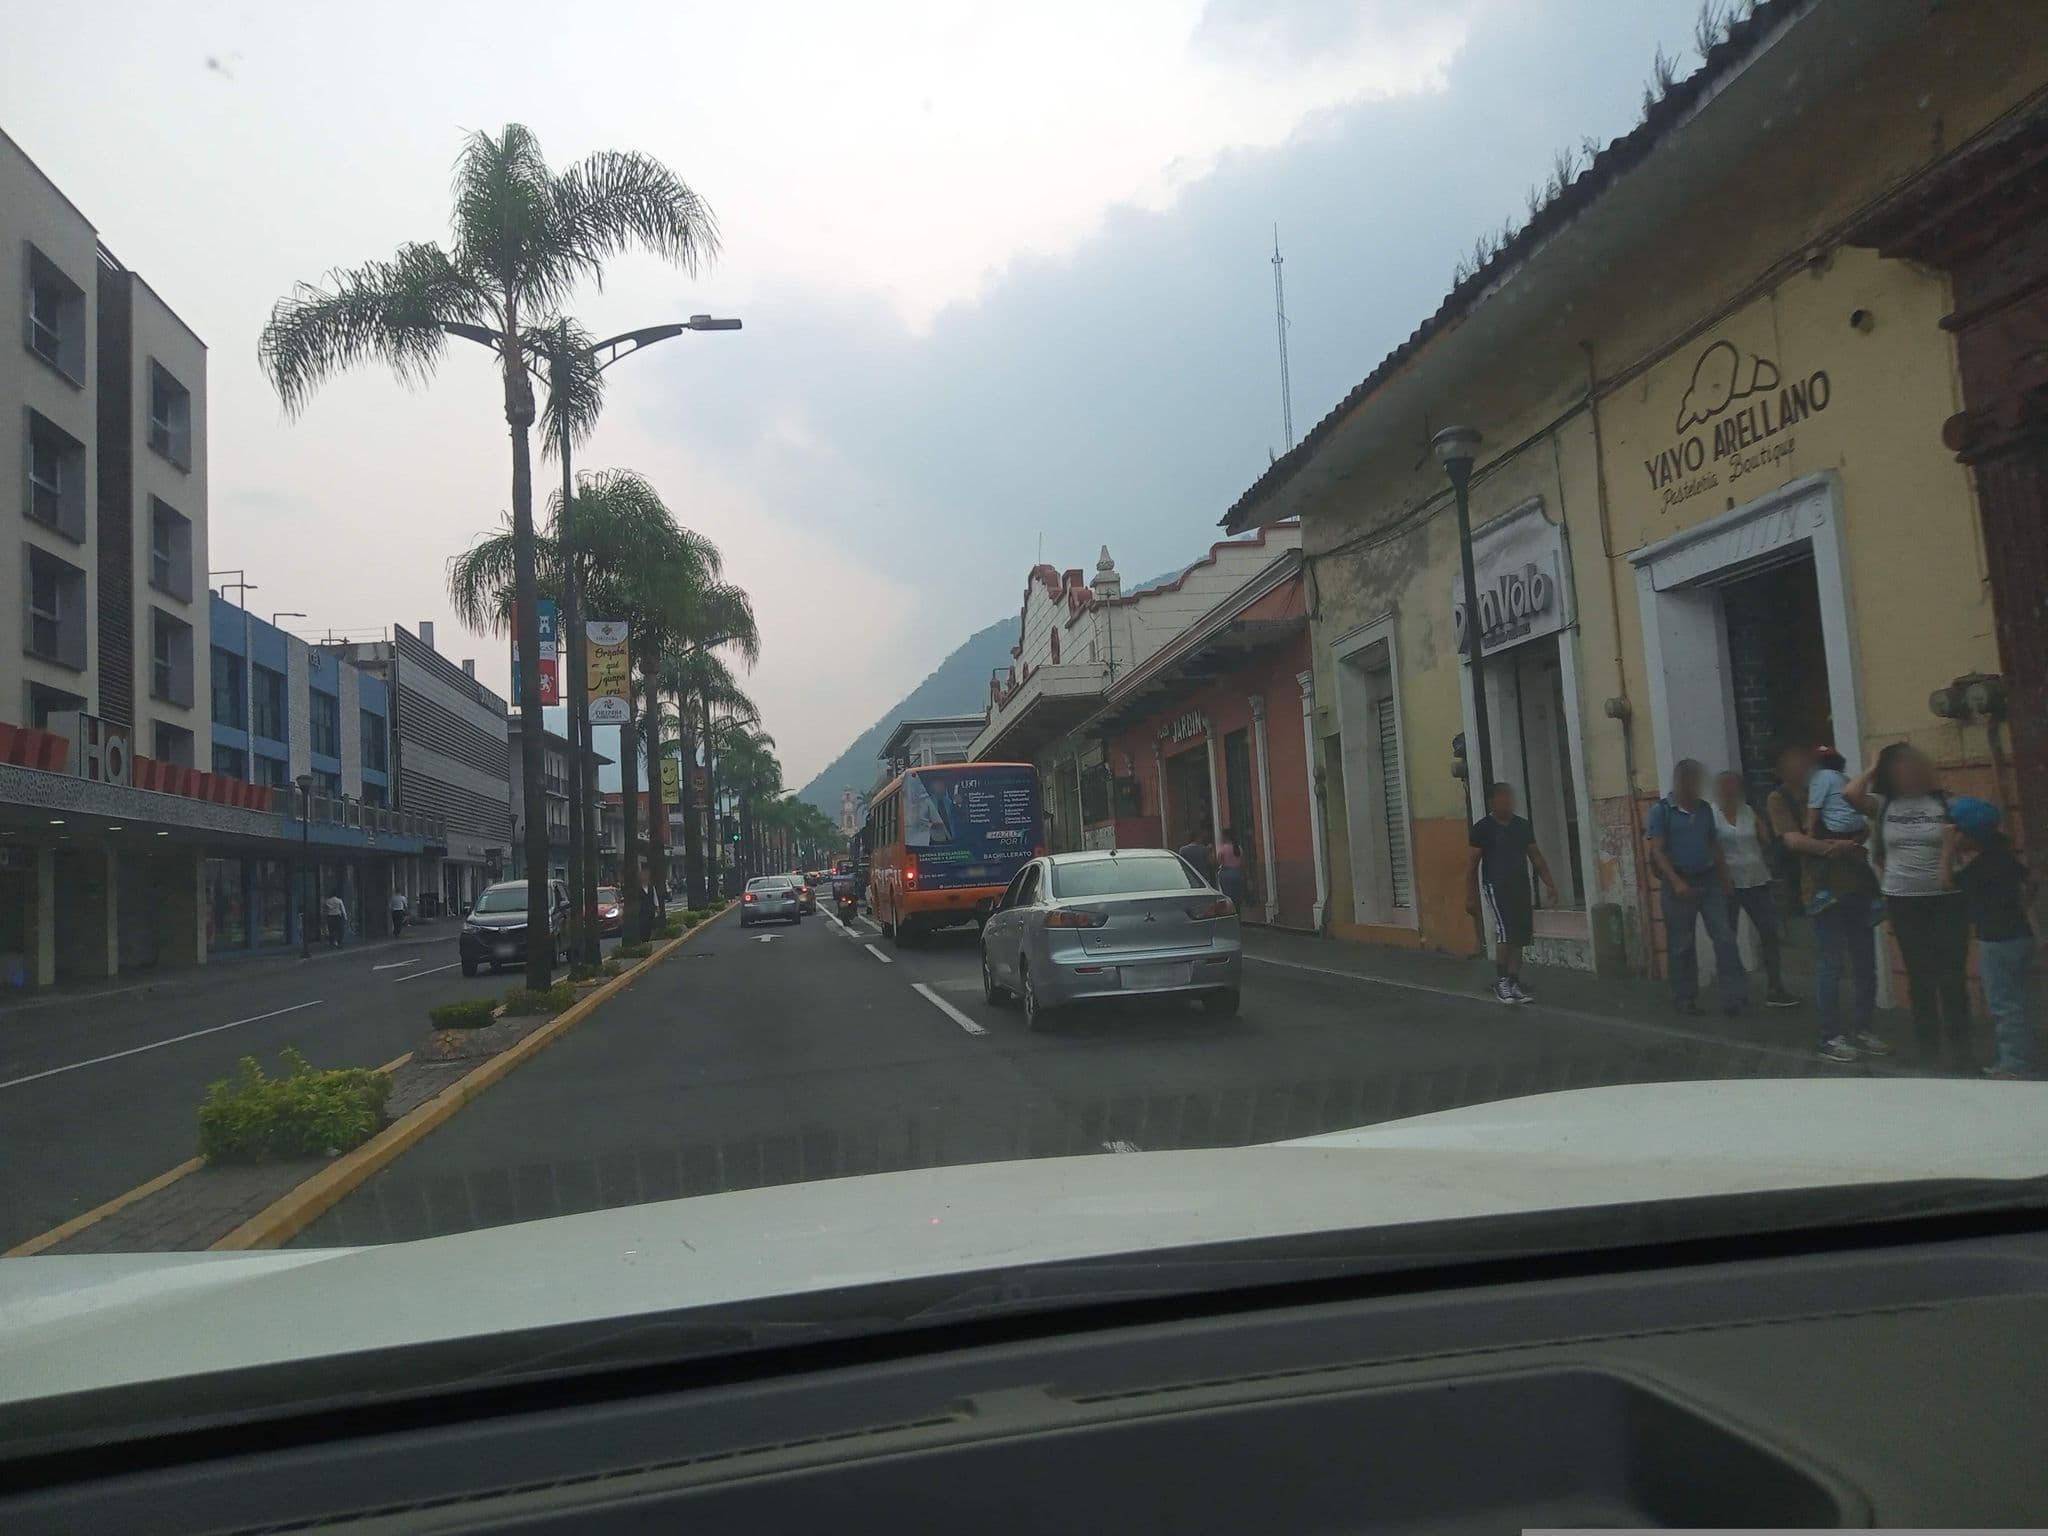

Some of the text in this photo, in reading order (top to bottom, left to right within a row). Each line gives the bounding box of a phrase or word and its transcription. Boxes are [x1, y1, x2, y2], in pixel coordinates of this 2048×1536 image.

[1644, 370, 1830, 491] YAYO ARELLANO
[1729, 437, 1796, 483] Boutique
[983, 850, 1032, 860] BACHILLERATO
